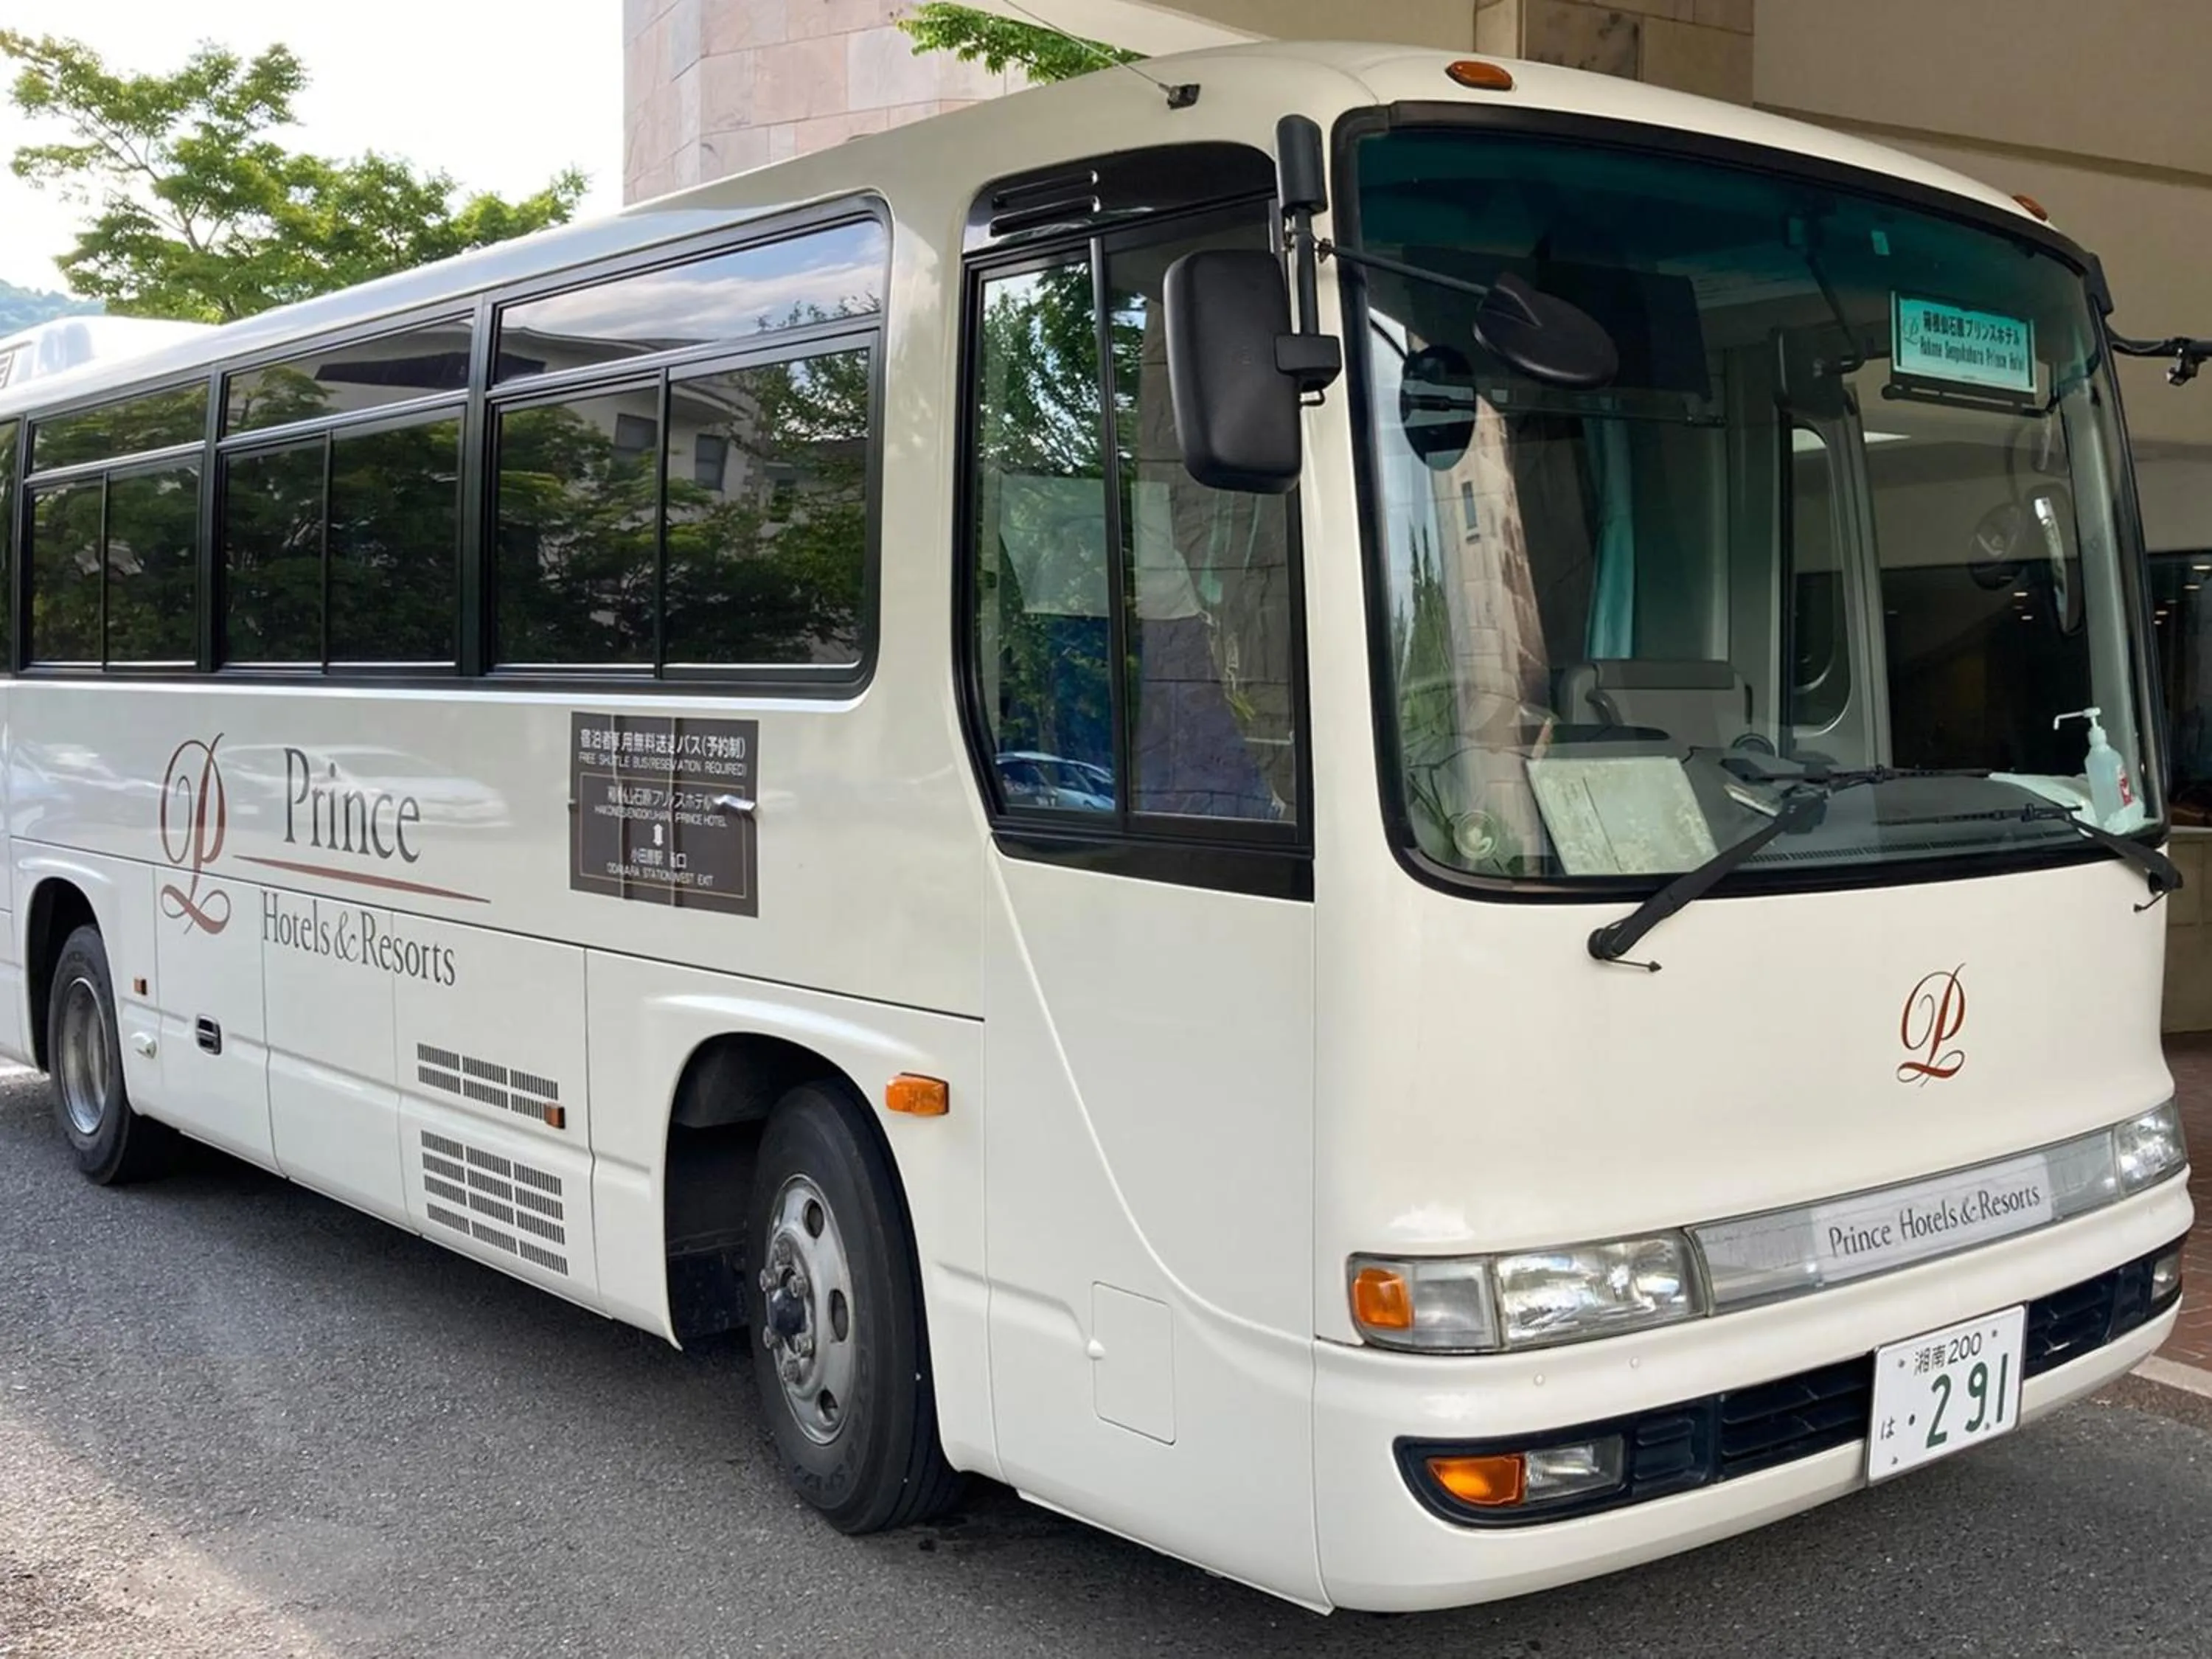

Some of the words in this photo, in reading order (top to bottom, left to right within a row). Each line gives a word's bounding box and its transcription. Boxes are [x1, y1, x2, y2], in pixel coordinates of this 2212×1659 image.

[283, 747, 421, 863] Prince
[1828, 1223, 1893, 1257] Prince
[1881, 1416, 1896, 1441] は
